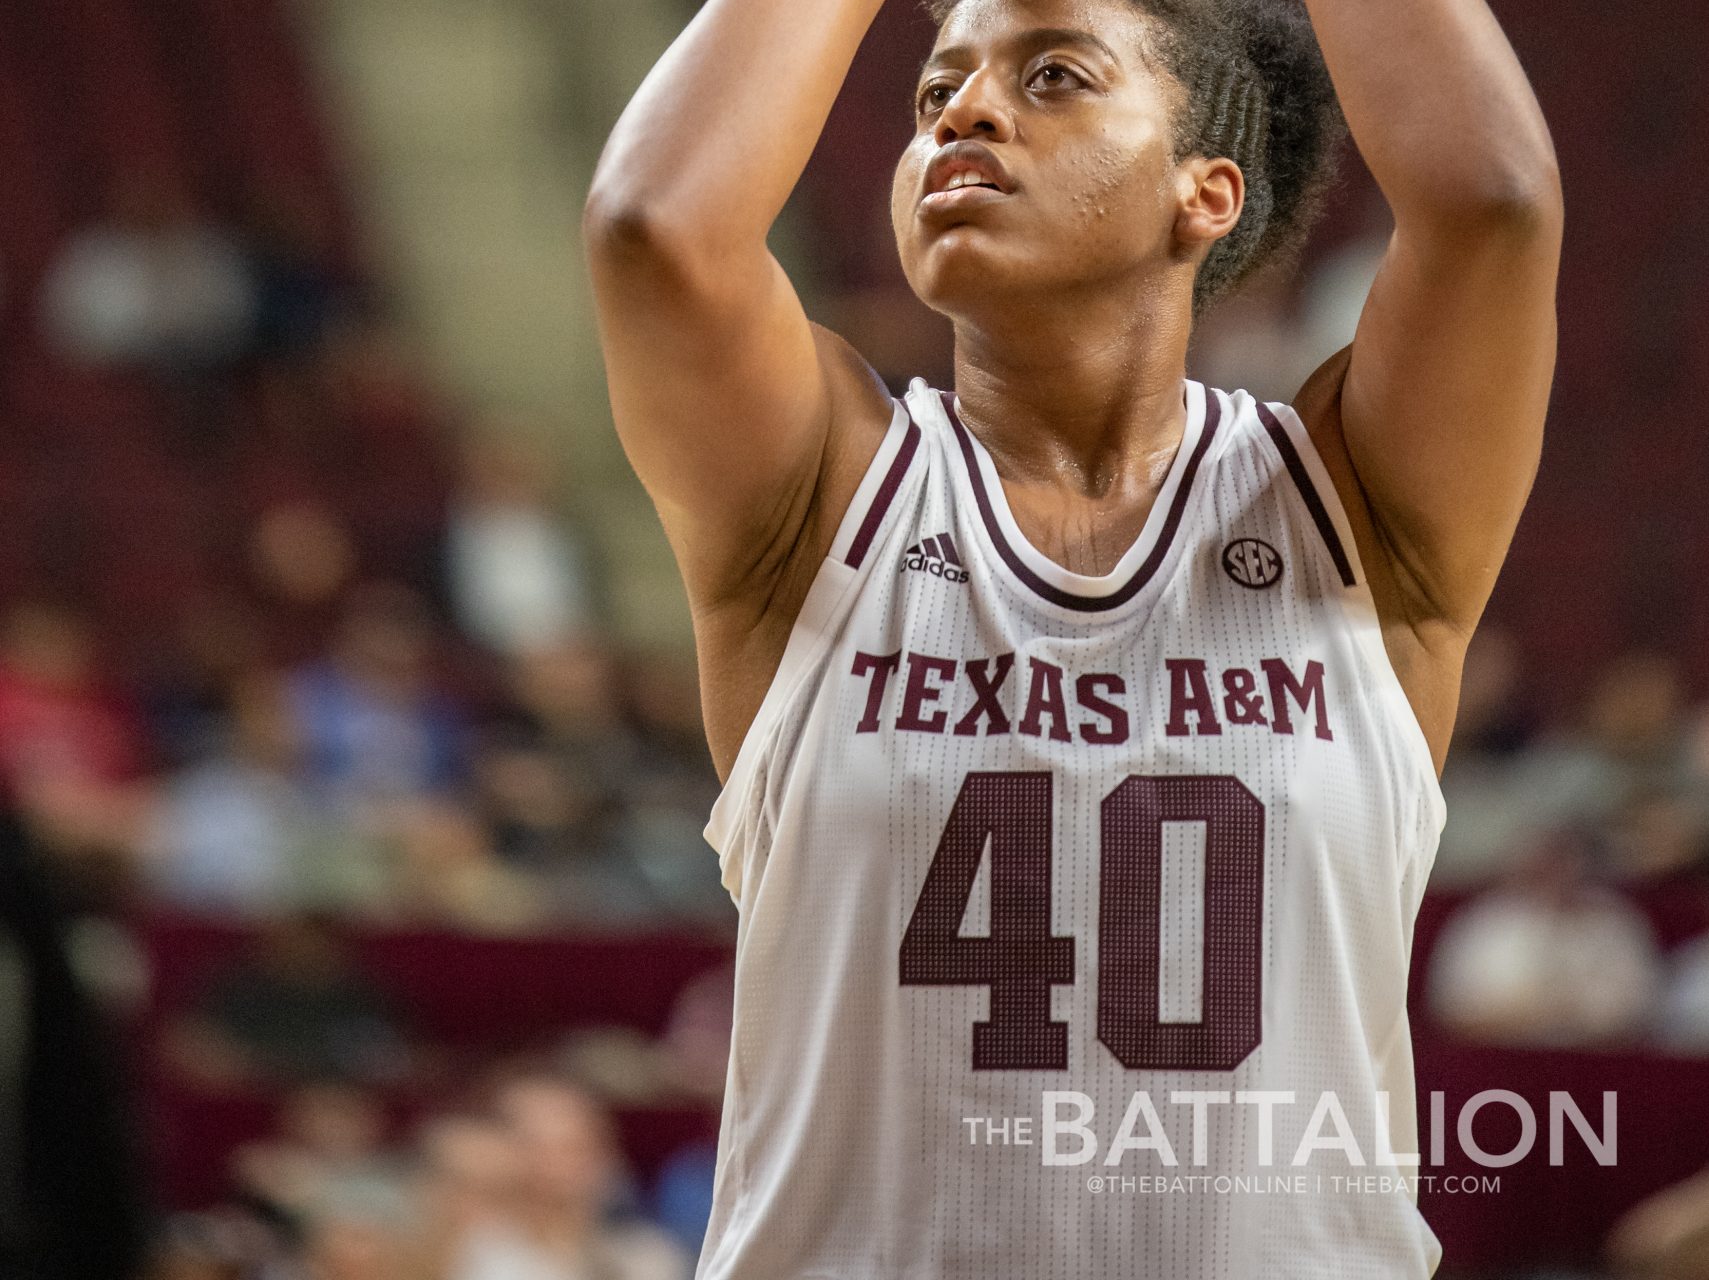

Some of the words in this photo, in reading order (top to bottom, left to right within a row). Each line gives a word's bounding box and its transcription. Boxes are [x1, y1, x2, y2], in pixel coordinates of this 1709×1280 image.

[1226, 540, 1280, 586] SEC
[850, 651, 1131, 746] TEXAS
[1165, 657, 1334, 742] A&M
[899, 770, 1266, 1072] 40
